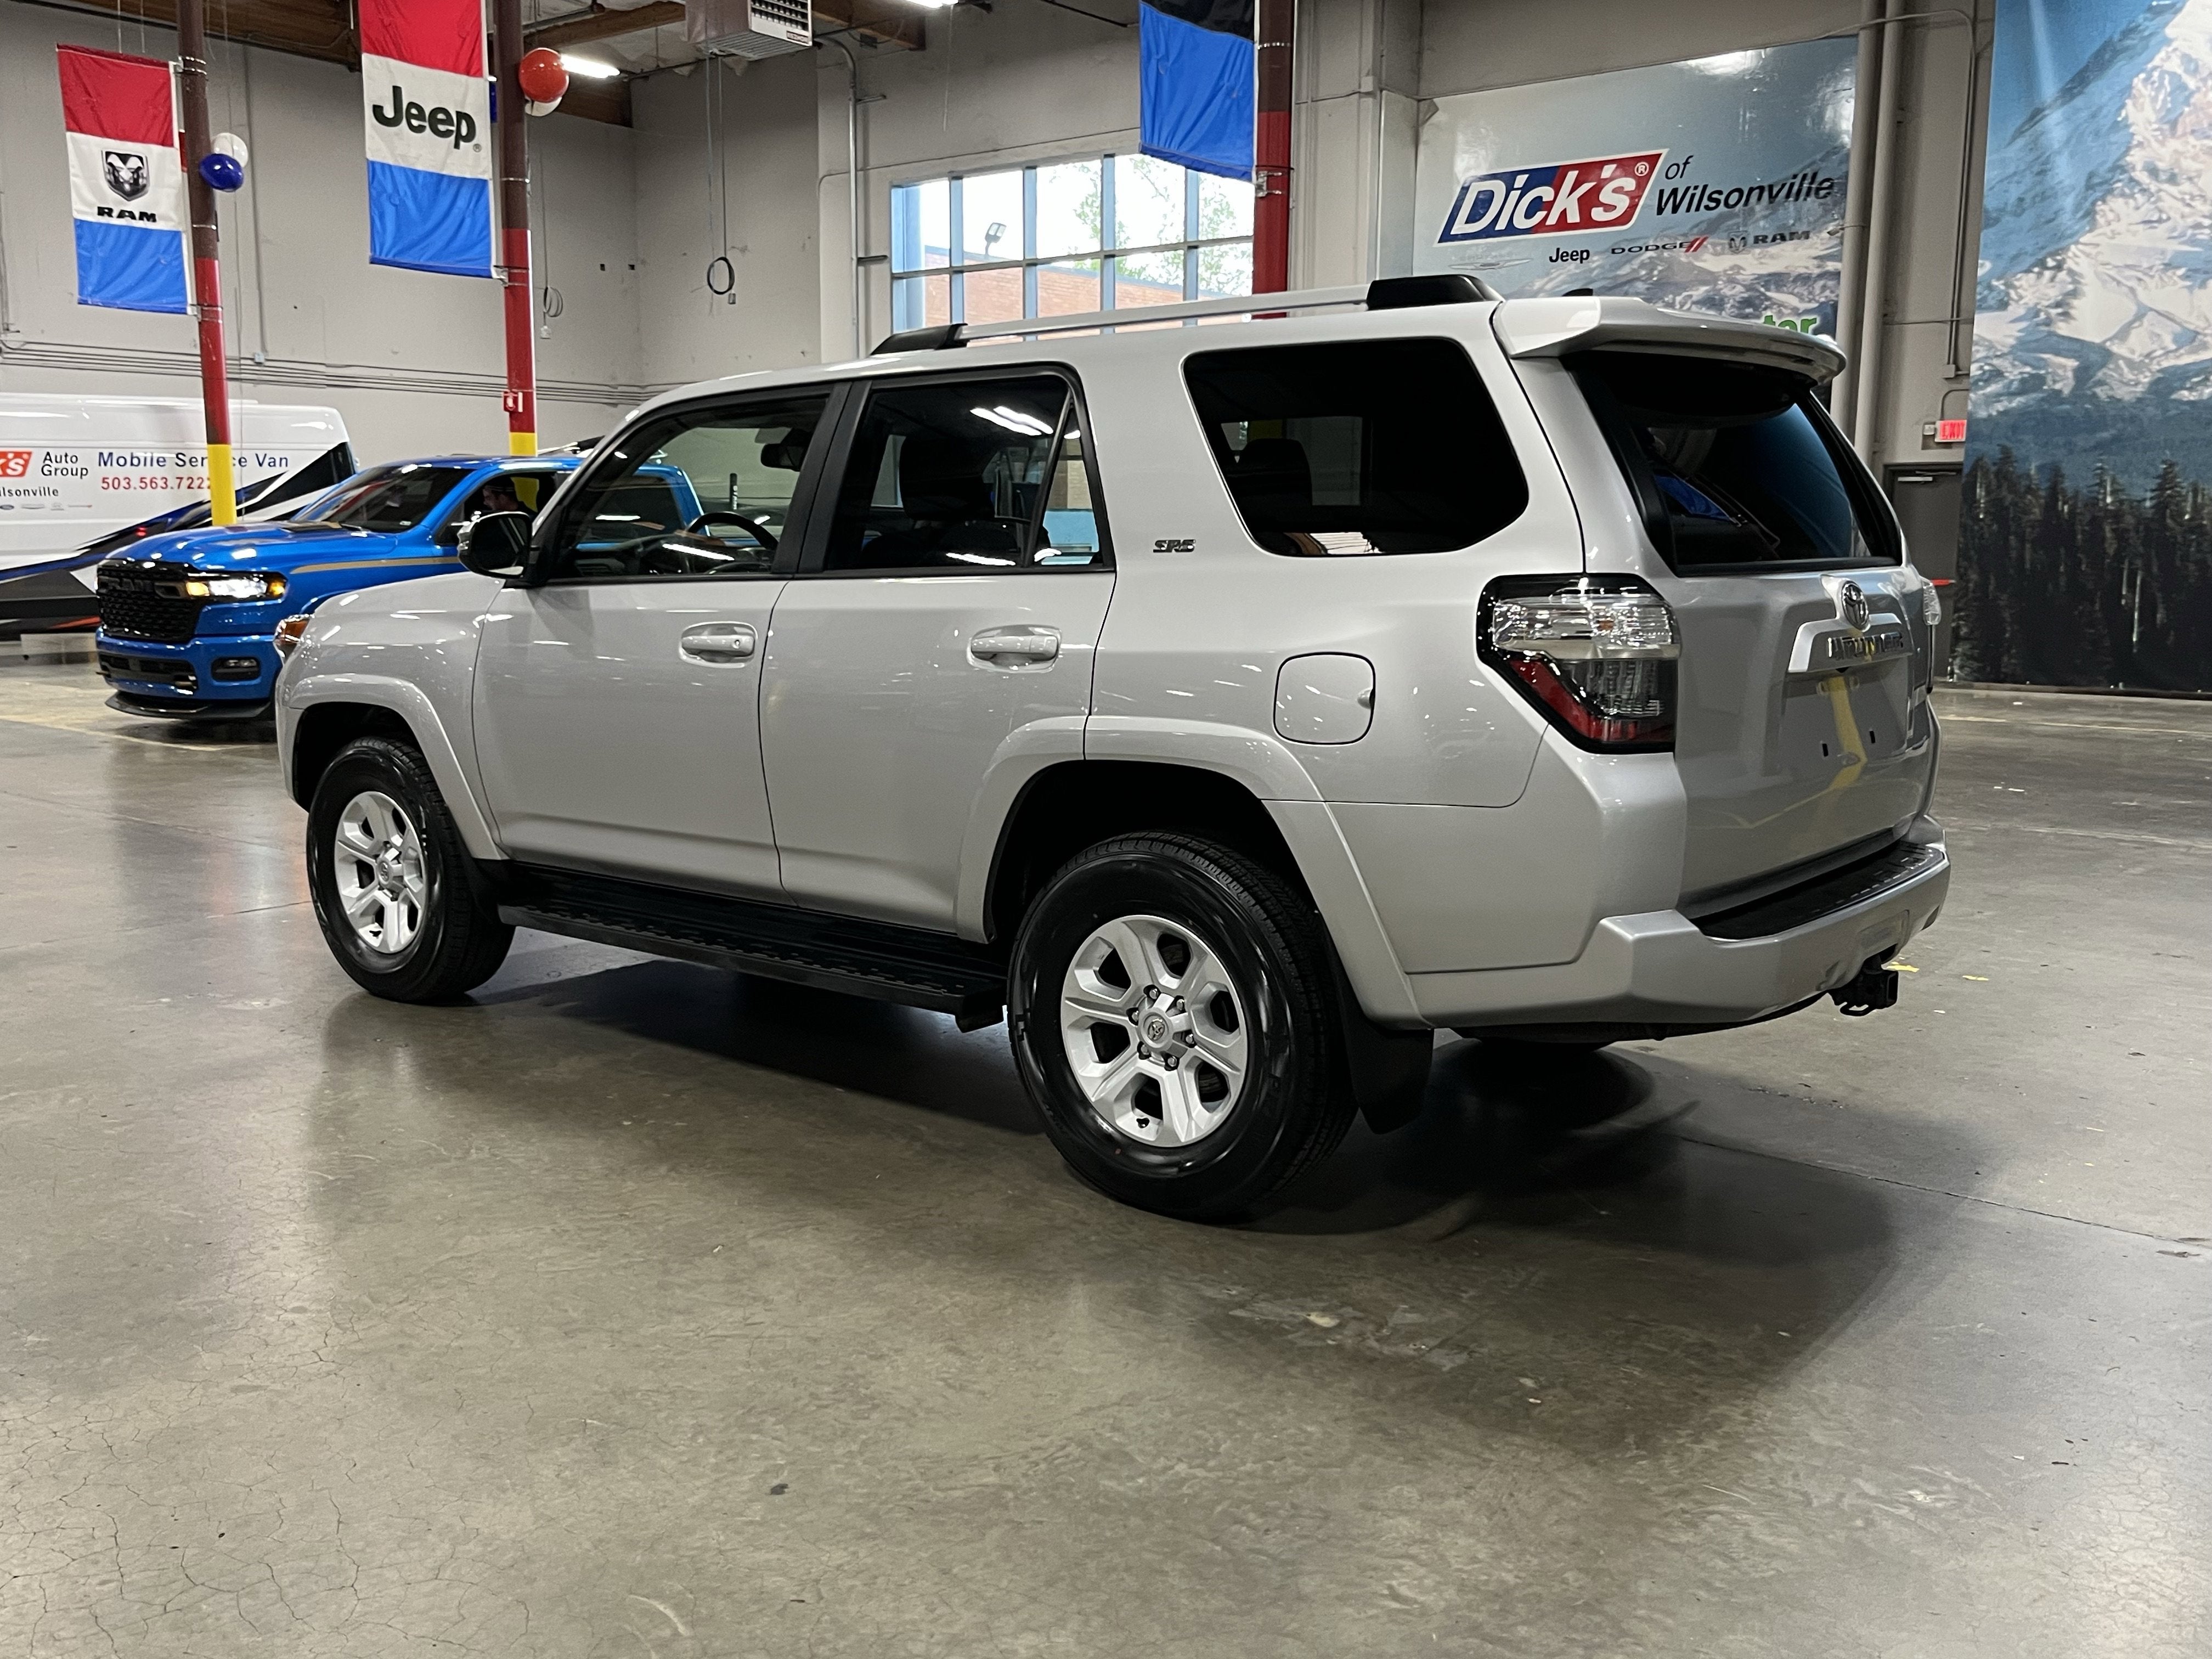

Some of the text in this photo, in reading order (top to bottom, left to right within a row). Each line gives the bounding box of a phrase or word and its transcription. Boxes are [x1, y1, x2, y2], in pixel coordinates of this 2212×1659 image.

[373, 85, 476, 150] Jeep
[1664, 155, 1694, 180] of
[1656, 172, 1835, 216] Wilsonville
[97, 206, 157, 223] RAM
[1549, 230, 1811, 264] Jeep DODGE RAM
[43, 451, 78, 464] Auto
[98, 452, 289, 467] Mobile Sere Van
[41, 464, 89, 479] Group
[101, 476, 211, 490] 503.563.722
